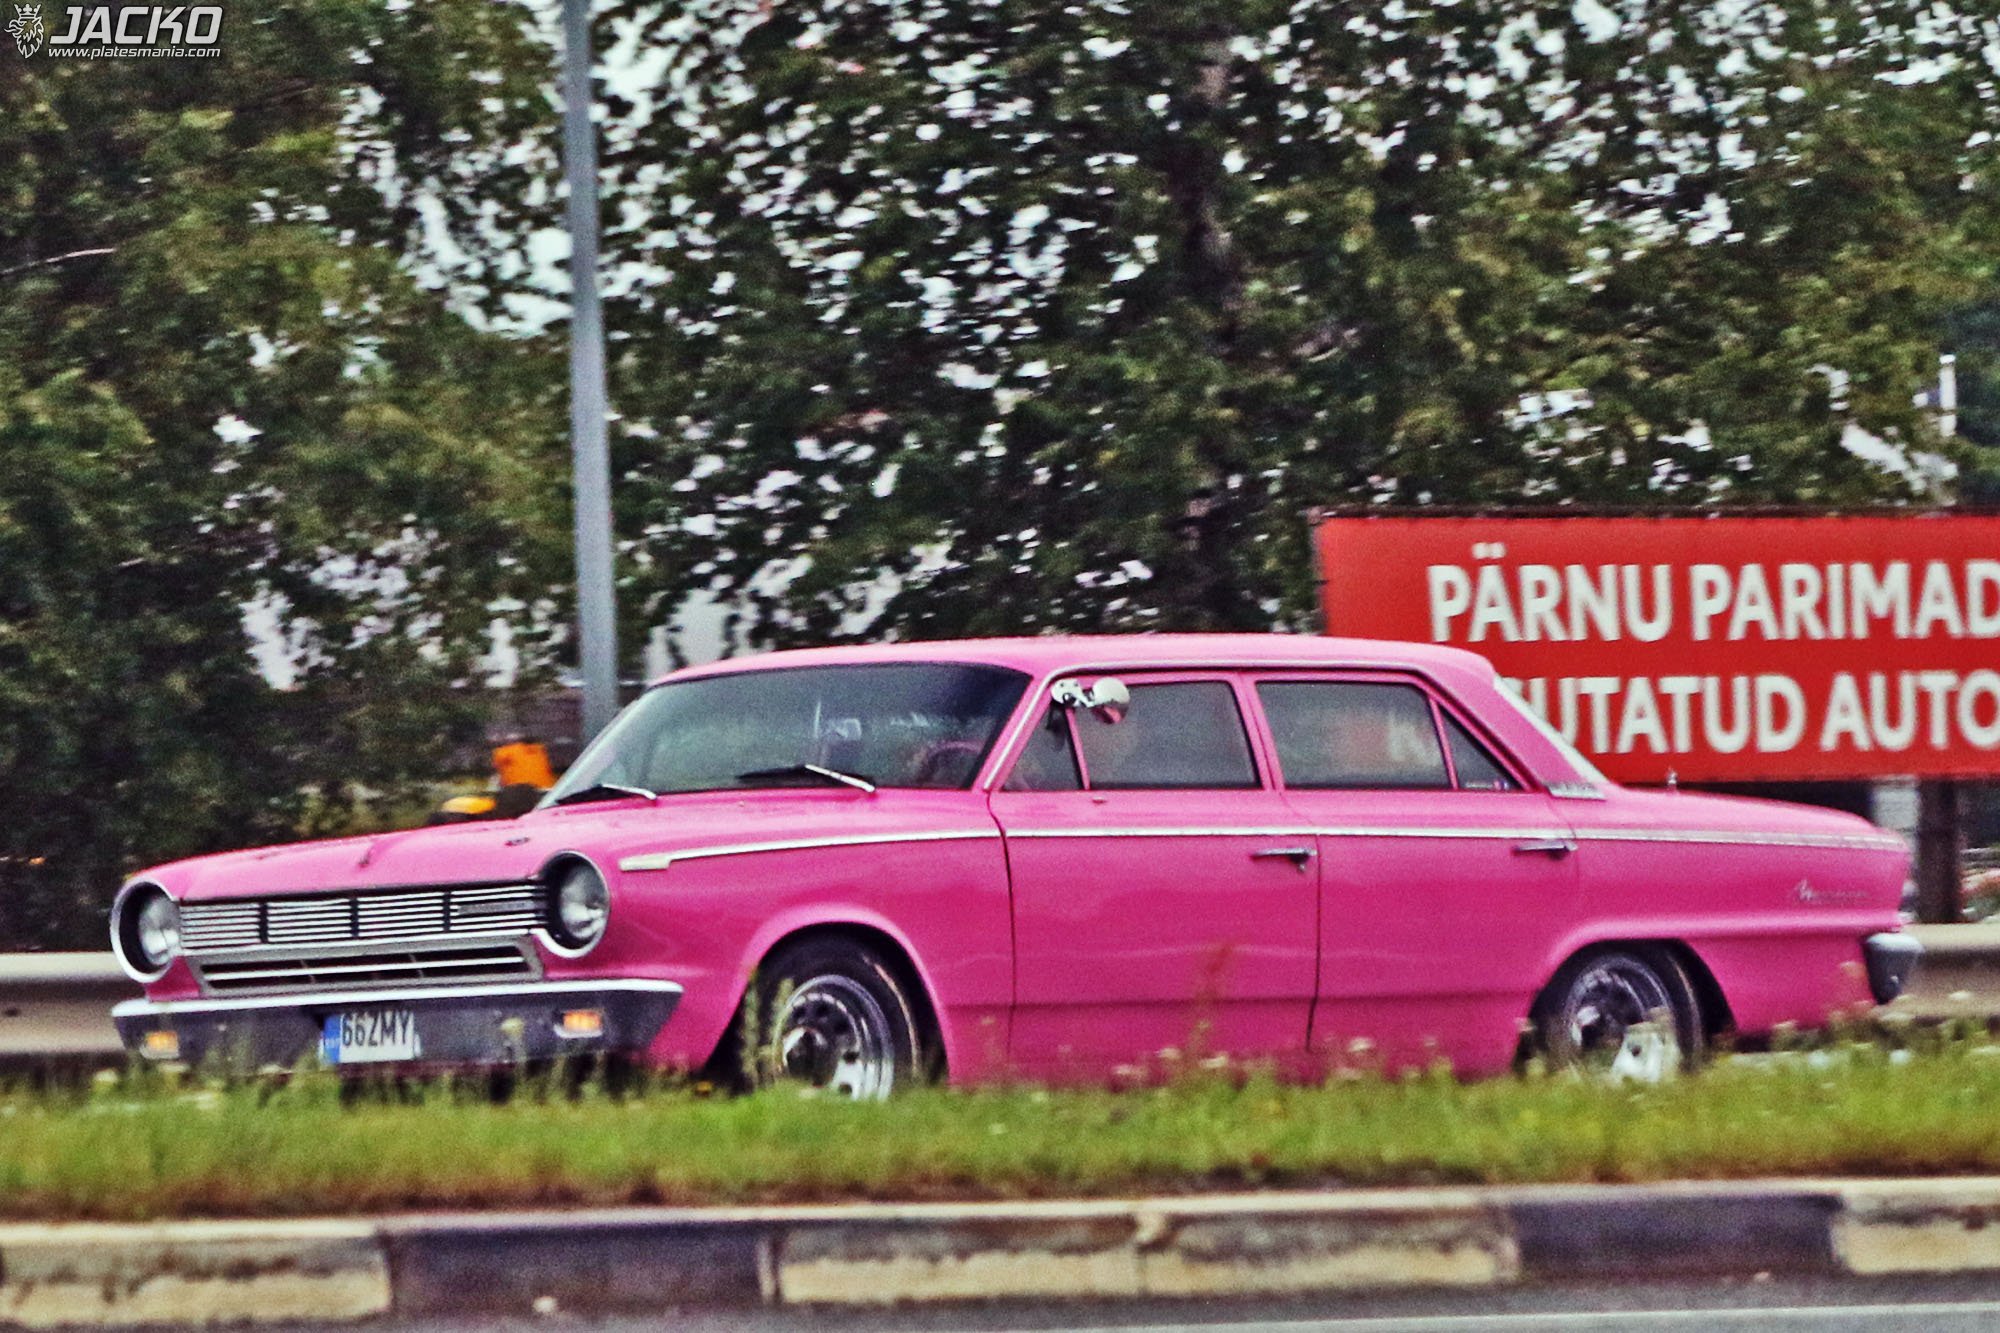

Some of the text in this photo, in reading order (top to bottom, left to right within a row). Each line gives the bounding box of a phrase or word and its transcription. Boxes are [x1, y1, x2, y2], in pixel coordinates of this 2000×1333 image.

[1428, 542, 2000, 642] PÄRNU PARIMAD
[1502, 675, 1806, 754] UTATUD
